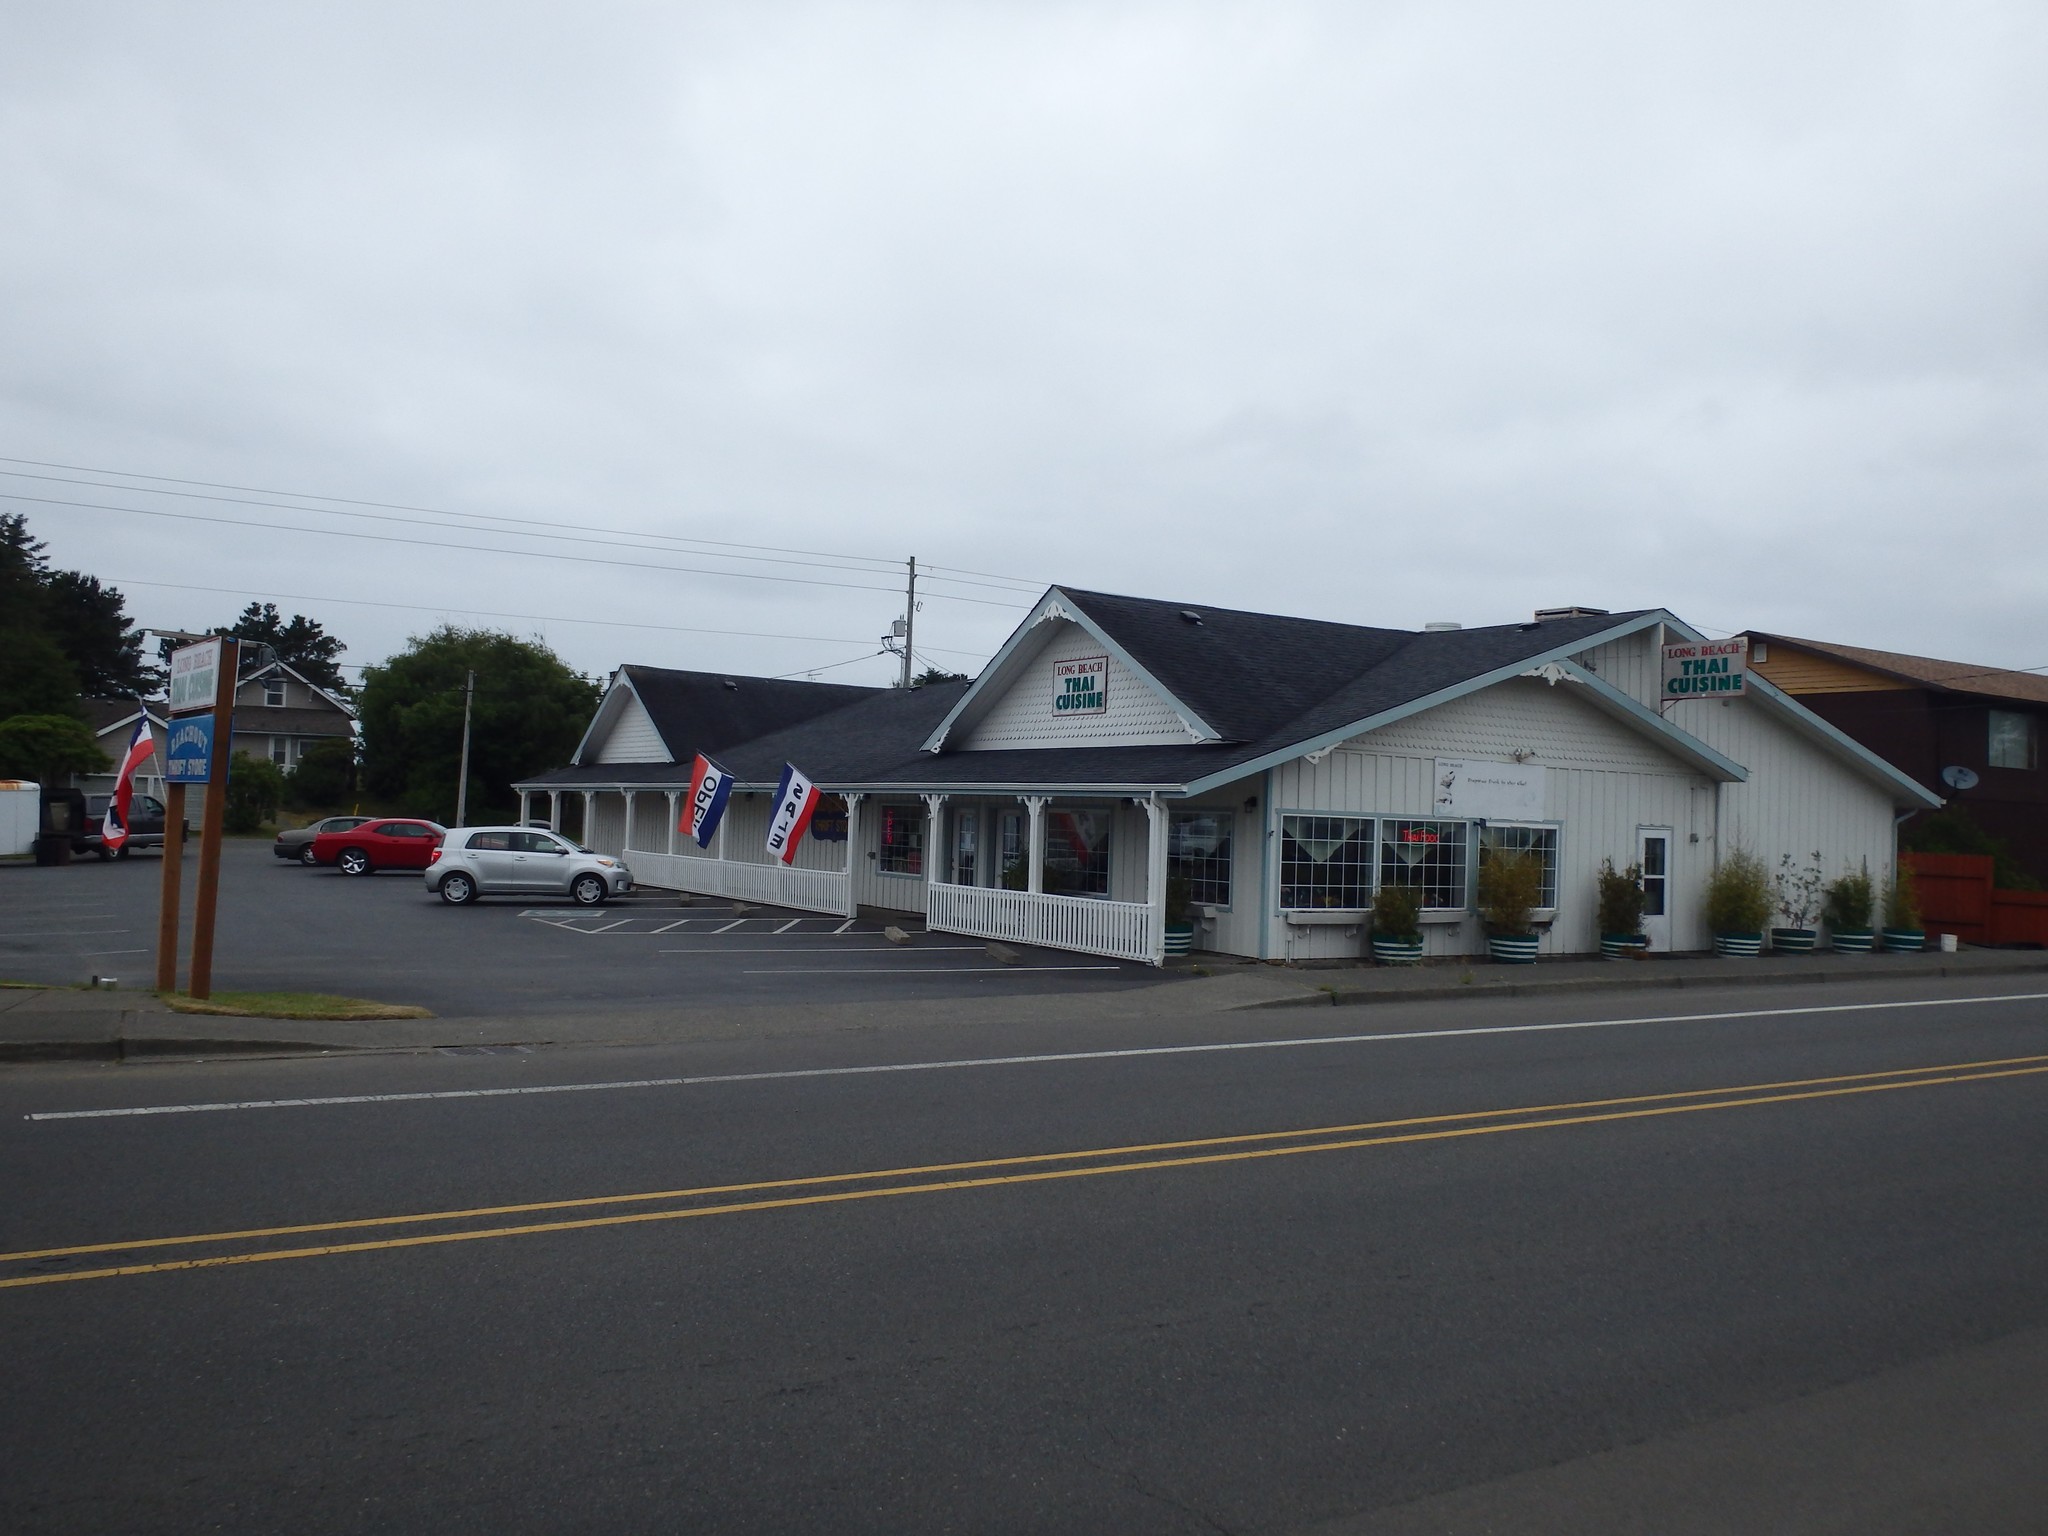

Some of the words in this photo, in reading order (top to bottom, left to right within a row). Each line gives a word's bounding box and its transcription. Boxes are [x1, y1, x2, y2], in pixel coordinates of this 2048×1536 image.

[1668, 646, 1696, 659] LONG
[1701, 643, 1739, 656] BEACH
[1057, 665, 1076, 676] LONG
[1078, 662, 1103, 674] BEACH
[1681, 657, 1728, 676] THAI
[1064, 676, 1095, 694] THAI
[1667, 674, 1742, 693] CUISINE
[1055, 692, 1103, 710] CUISINE
[187, 758, 207, 775] STORE
